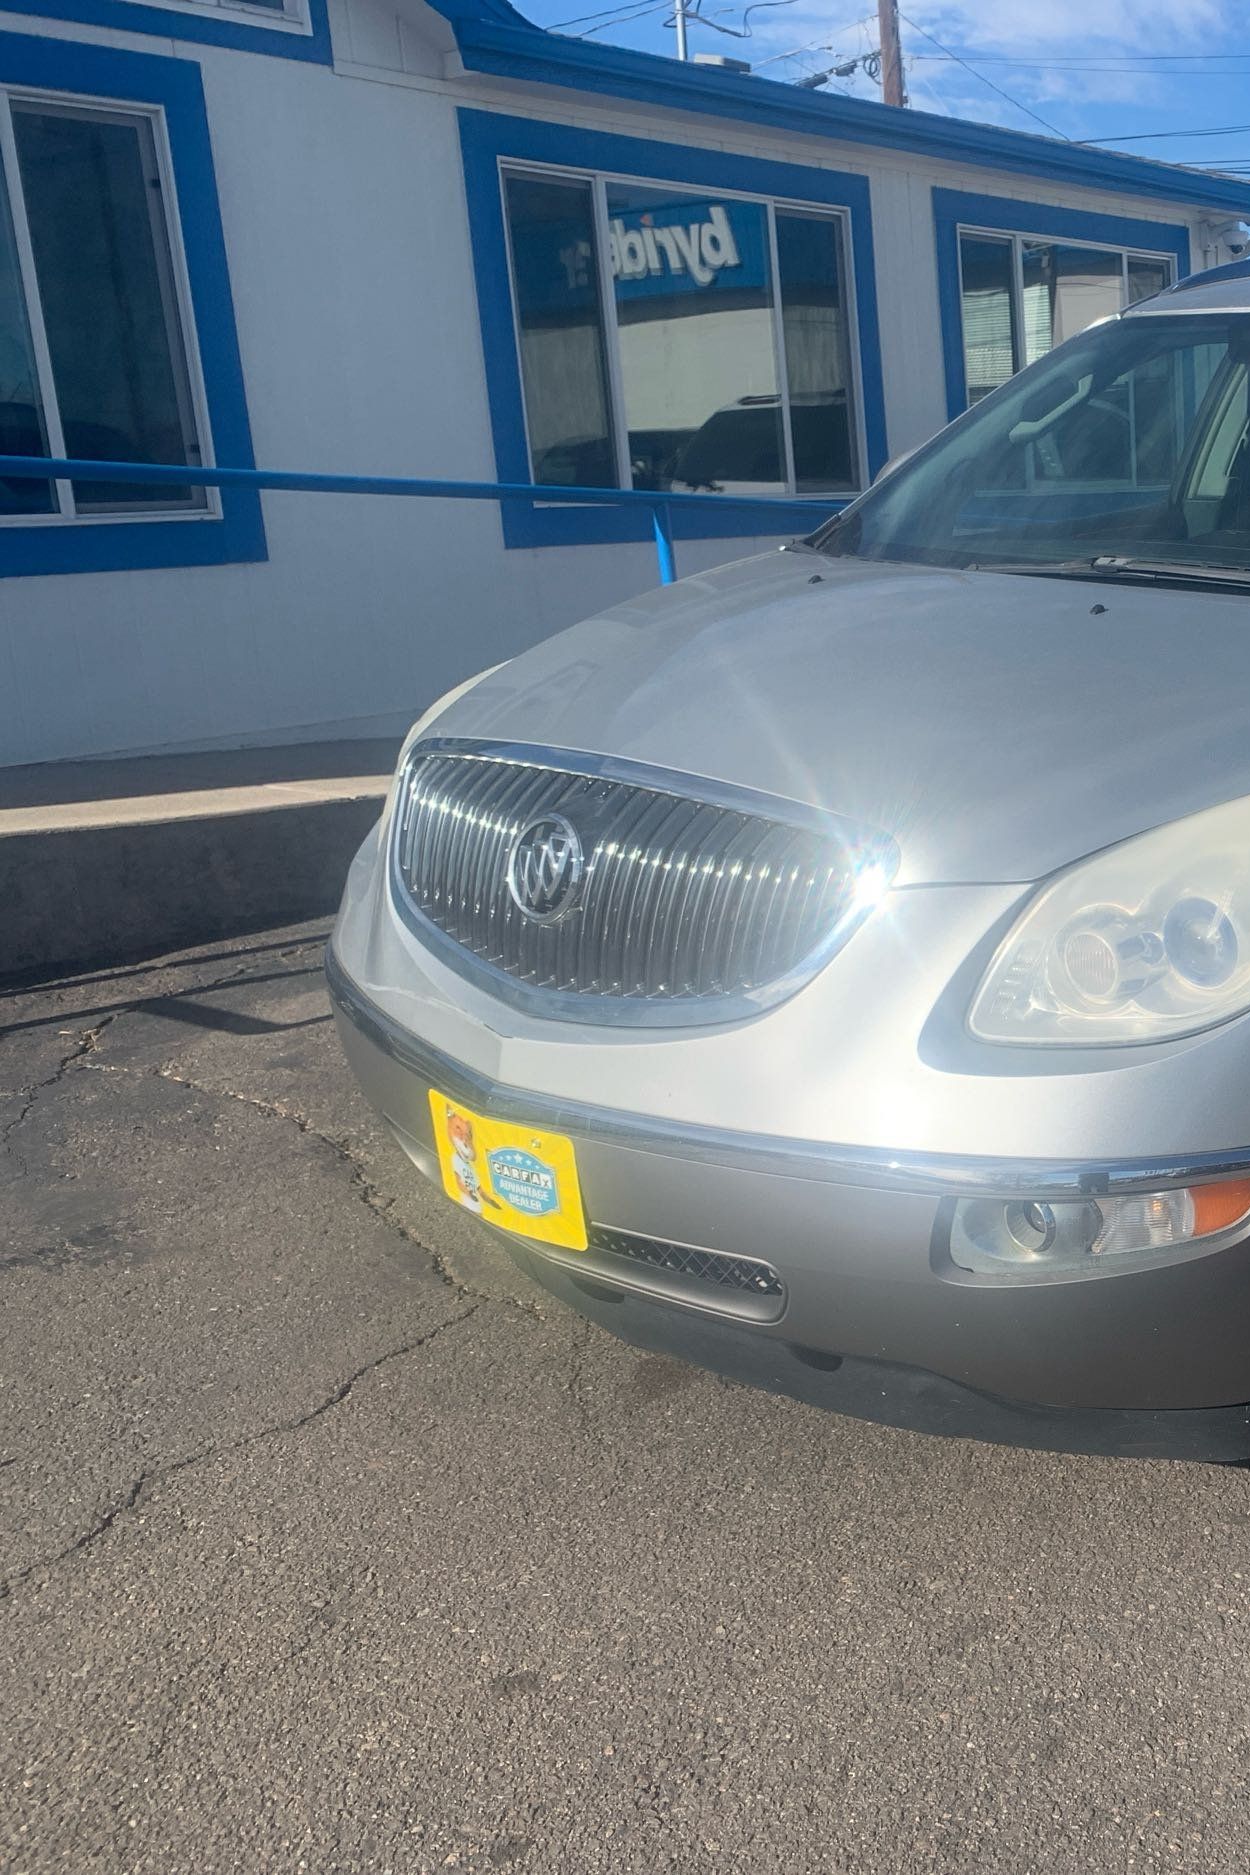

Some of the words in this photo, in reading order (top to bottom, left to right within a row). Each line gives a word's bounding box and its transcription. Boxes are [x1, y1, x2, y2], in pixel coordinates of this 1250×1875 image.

[493, 1161, 552, 1190] CARFAX
[499, 1178, 550, 1202] ADVANTAGE
[508, 1193, 543, 1211] DEALER
